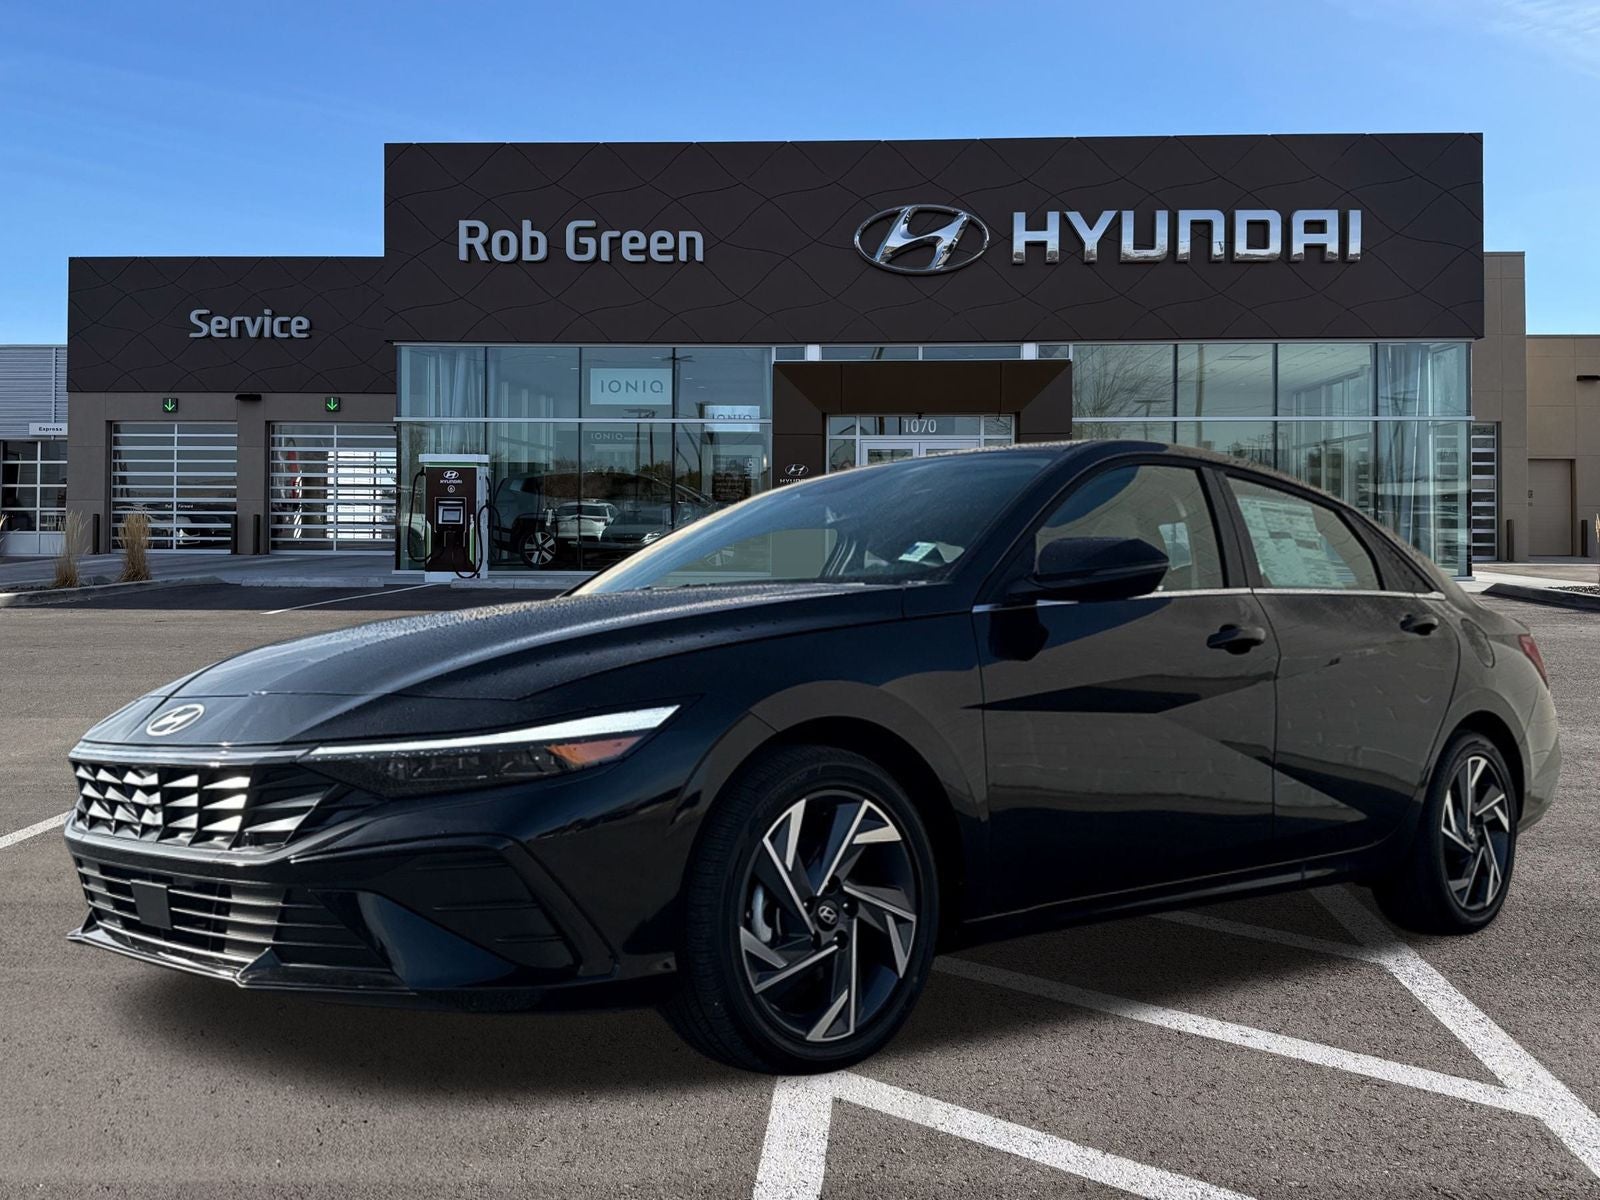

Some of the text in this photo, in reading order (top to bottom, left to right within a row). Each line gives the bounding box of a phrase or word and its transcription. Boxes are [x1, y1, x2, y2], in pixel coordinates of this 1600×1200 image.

[458, 219, 704, 262] Rob Green
[1011, 209, 1362, 264] HYUNDAI
[189, 308, 311, 339] Service
[600, 380, 664, 393] IONIQ
[904, 419, 937, 433] 1070
